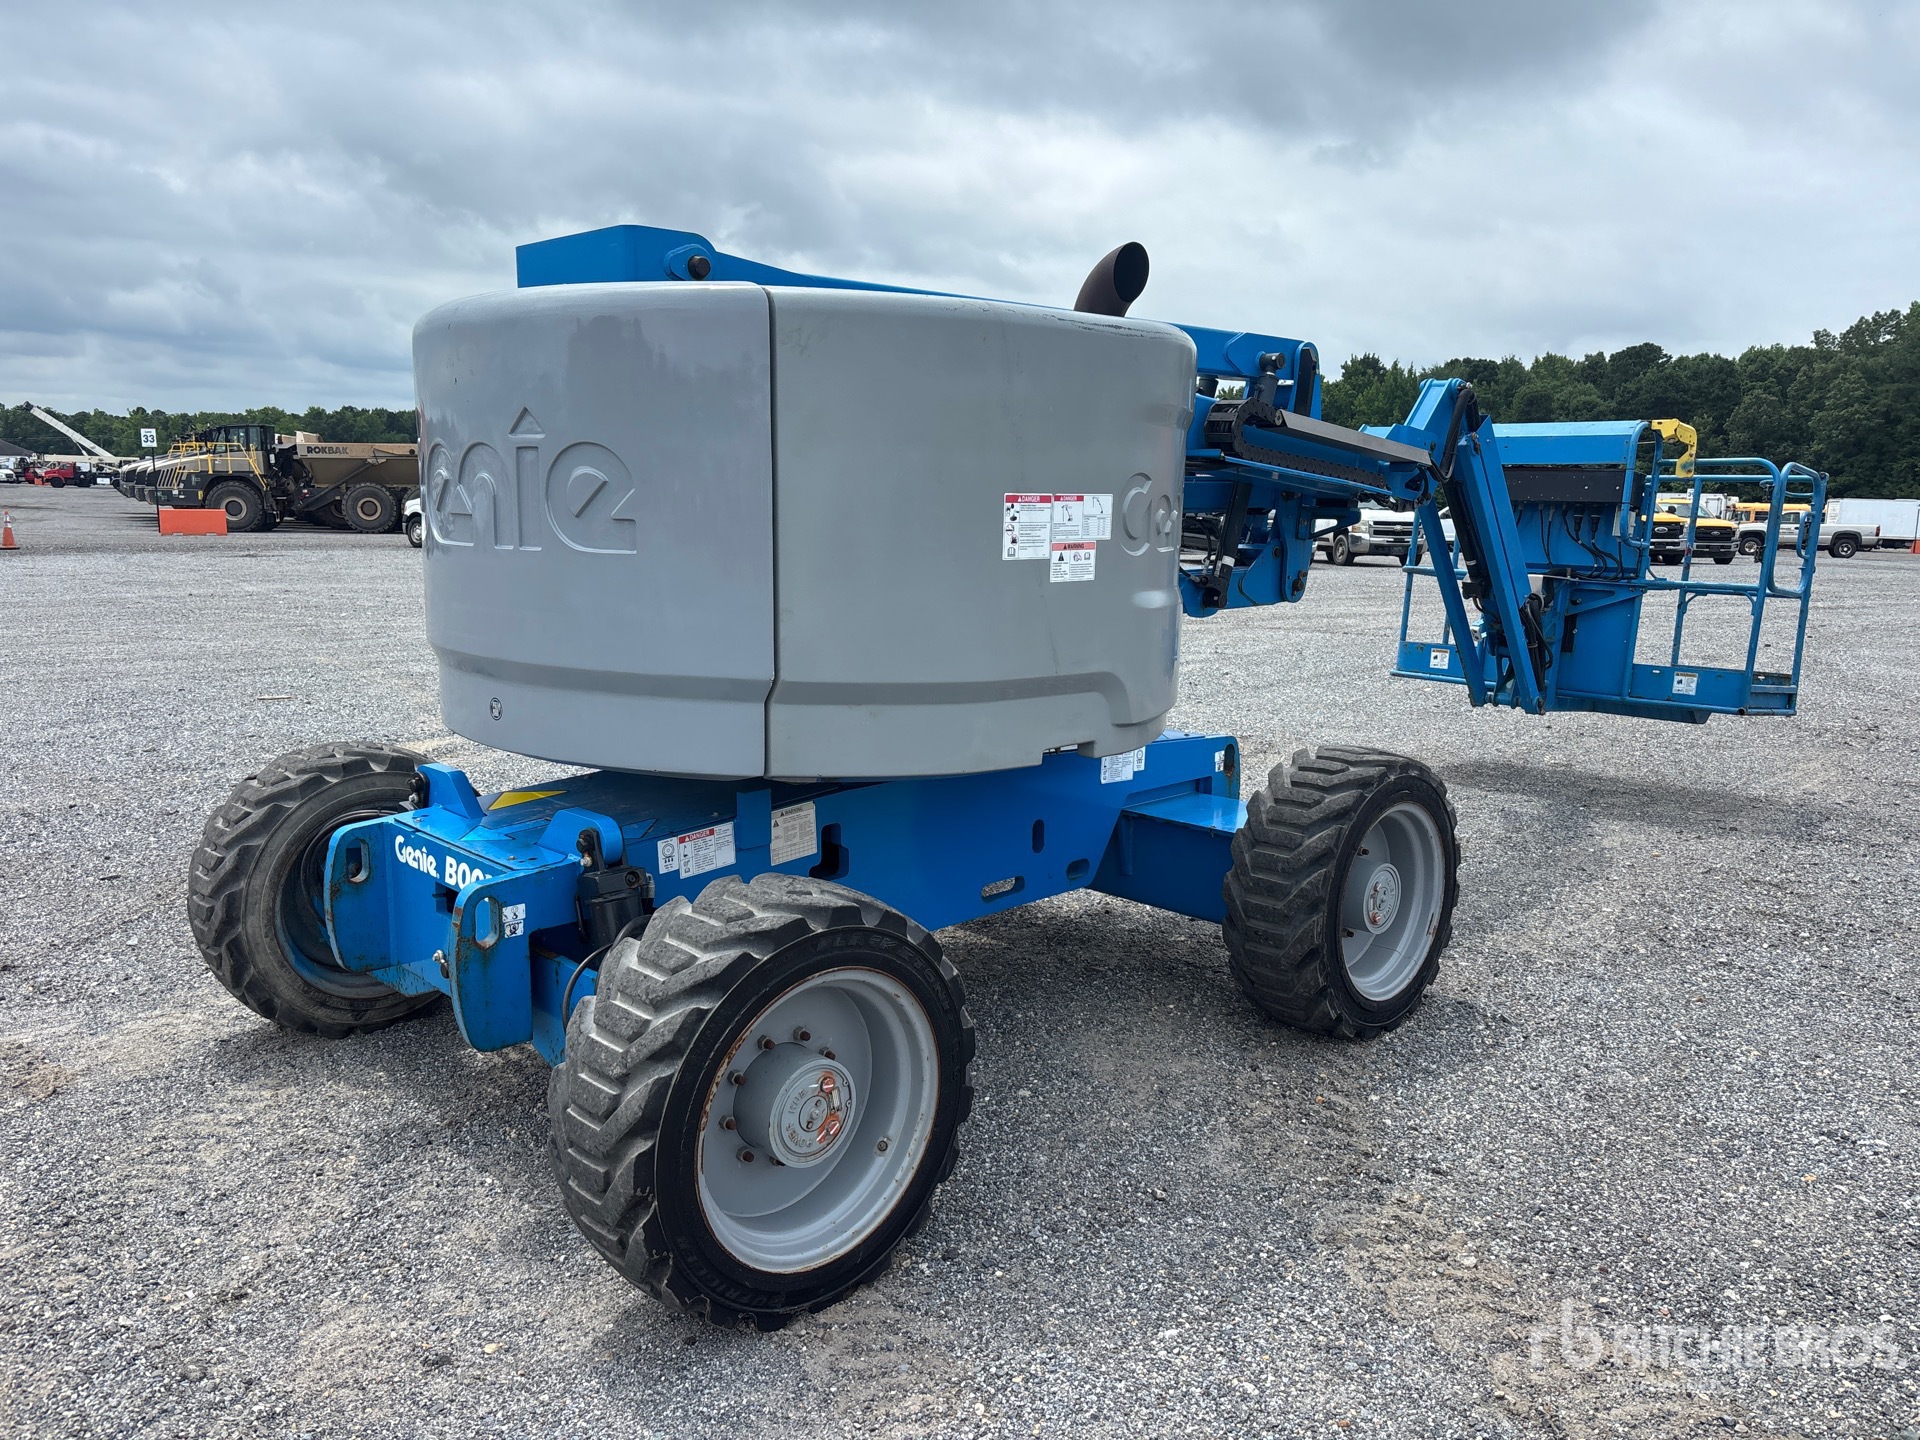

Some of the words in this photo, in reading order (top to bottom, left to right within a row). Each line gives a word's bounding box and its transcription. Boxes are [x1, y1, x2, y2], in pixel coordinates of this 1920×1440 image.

[143, 434, 155, 443] 33
[306, 446, 349, 455] ROKBAK
[689, 829, 710, 841] DANGER
[395, 834, 437, 879] Genie
[445, 855, 493, 890] BOO
